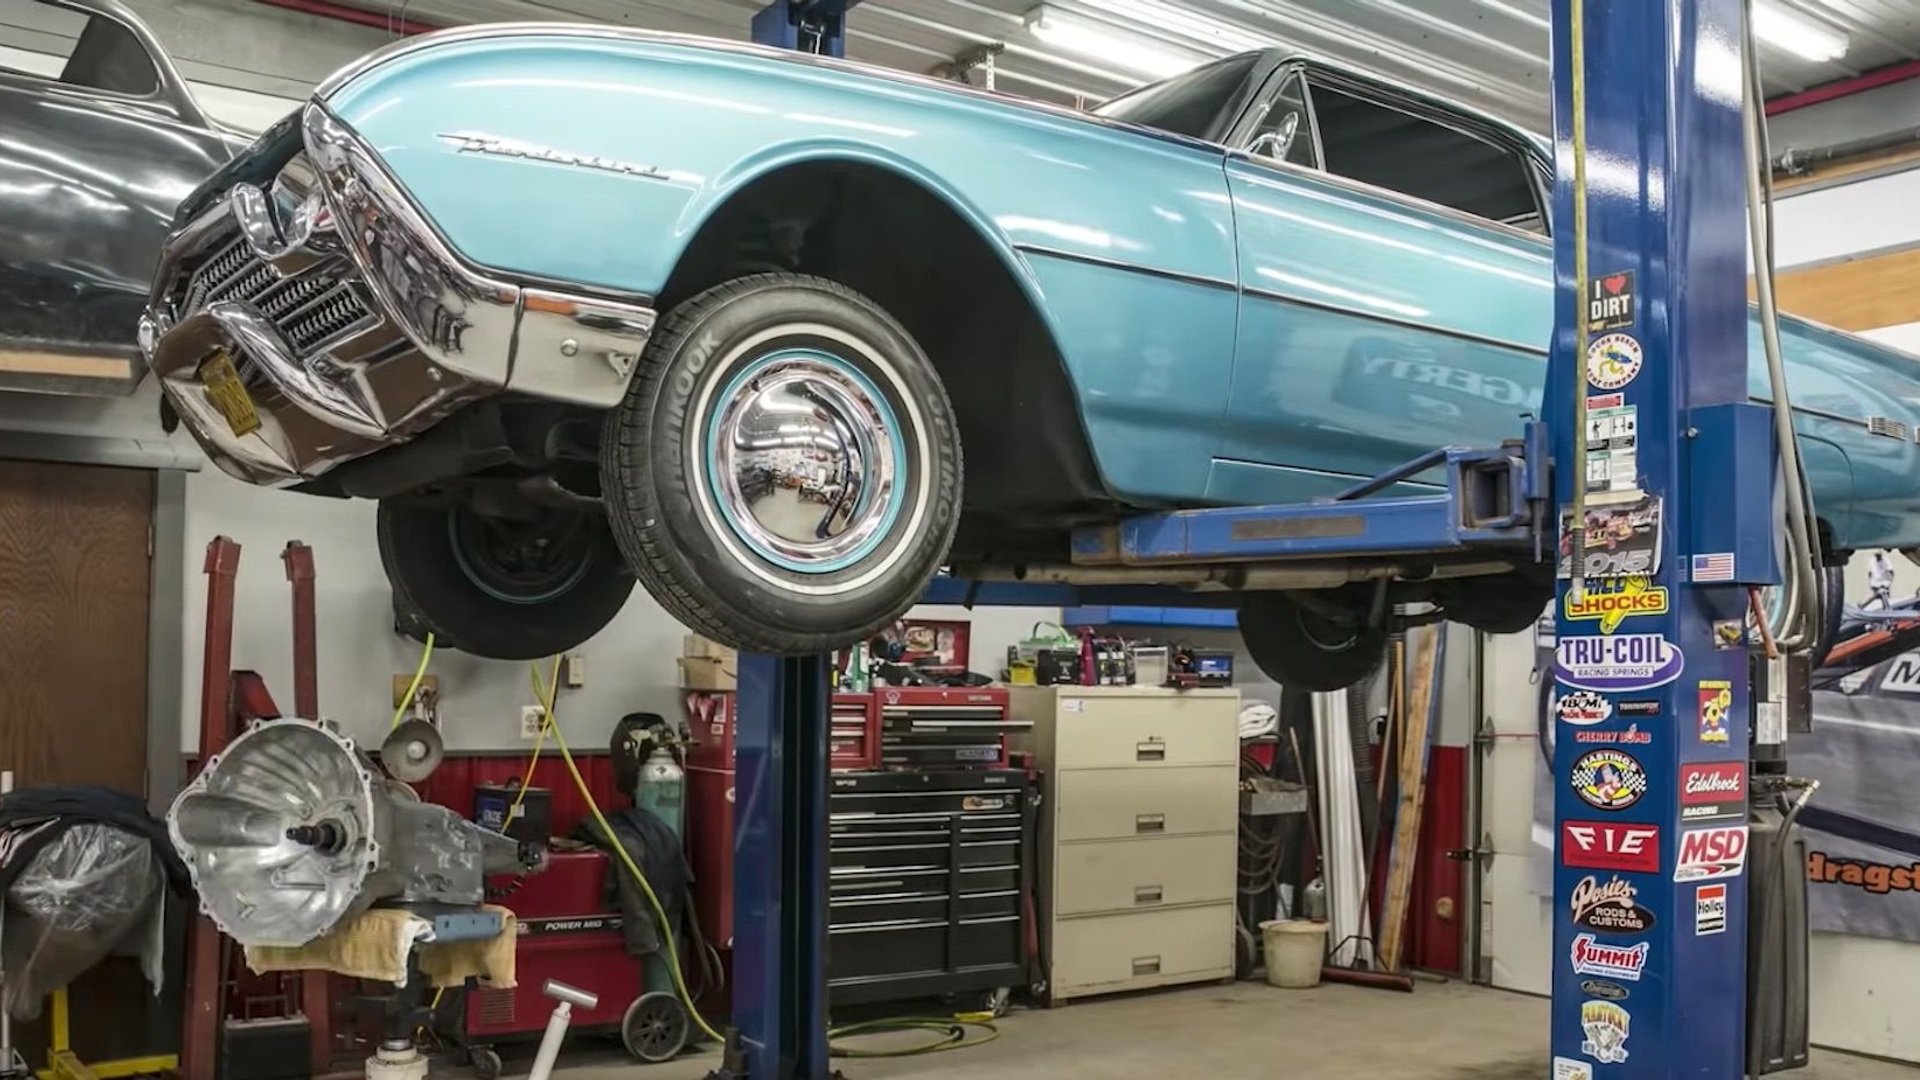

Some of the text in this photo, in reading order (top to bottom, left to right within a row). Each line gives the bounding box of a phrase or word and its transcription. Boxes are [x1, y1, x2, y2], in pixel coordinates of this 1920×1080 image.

[1594, 280, 1601, 299] I
[1590, 294, 1631, 320] DIRT
[928, 393, 955, 525] OPTIMO
[1562, 636, 1666, 665] TRU-COIL
[1578, 667, 1649, 676] RACING SPRINGS
[1686, 771, 1740, 794] Edelbrock
[1682, 806, 1719, 817] RACING
[1681, 830, 1745, 865] MSD
[1571, 874, 1638, 924] Posies
[1589, 915, 1644, 929] CUSTOMS
[1596, 907, 1637, 919] RODS &
[545, 920, 603, 931] POWER MIG
